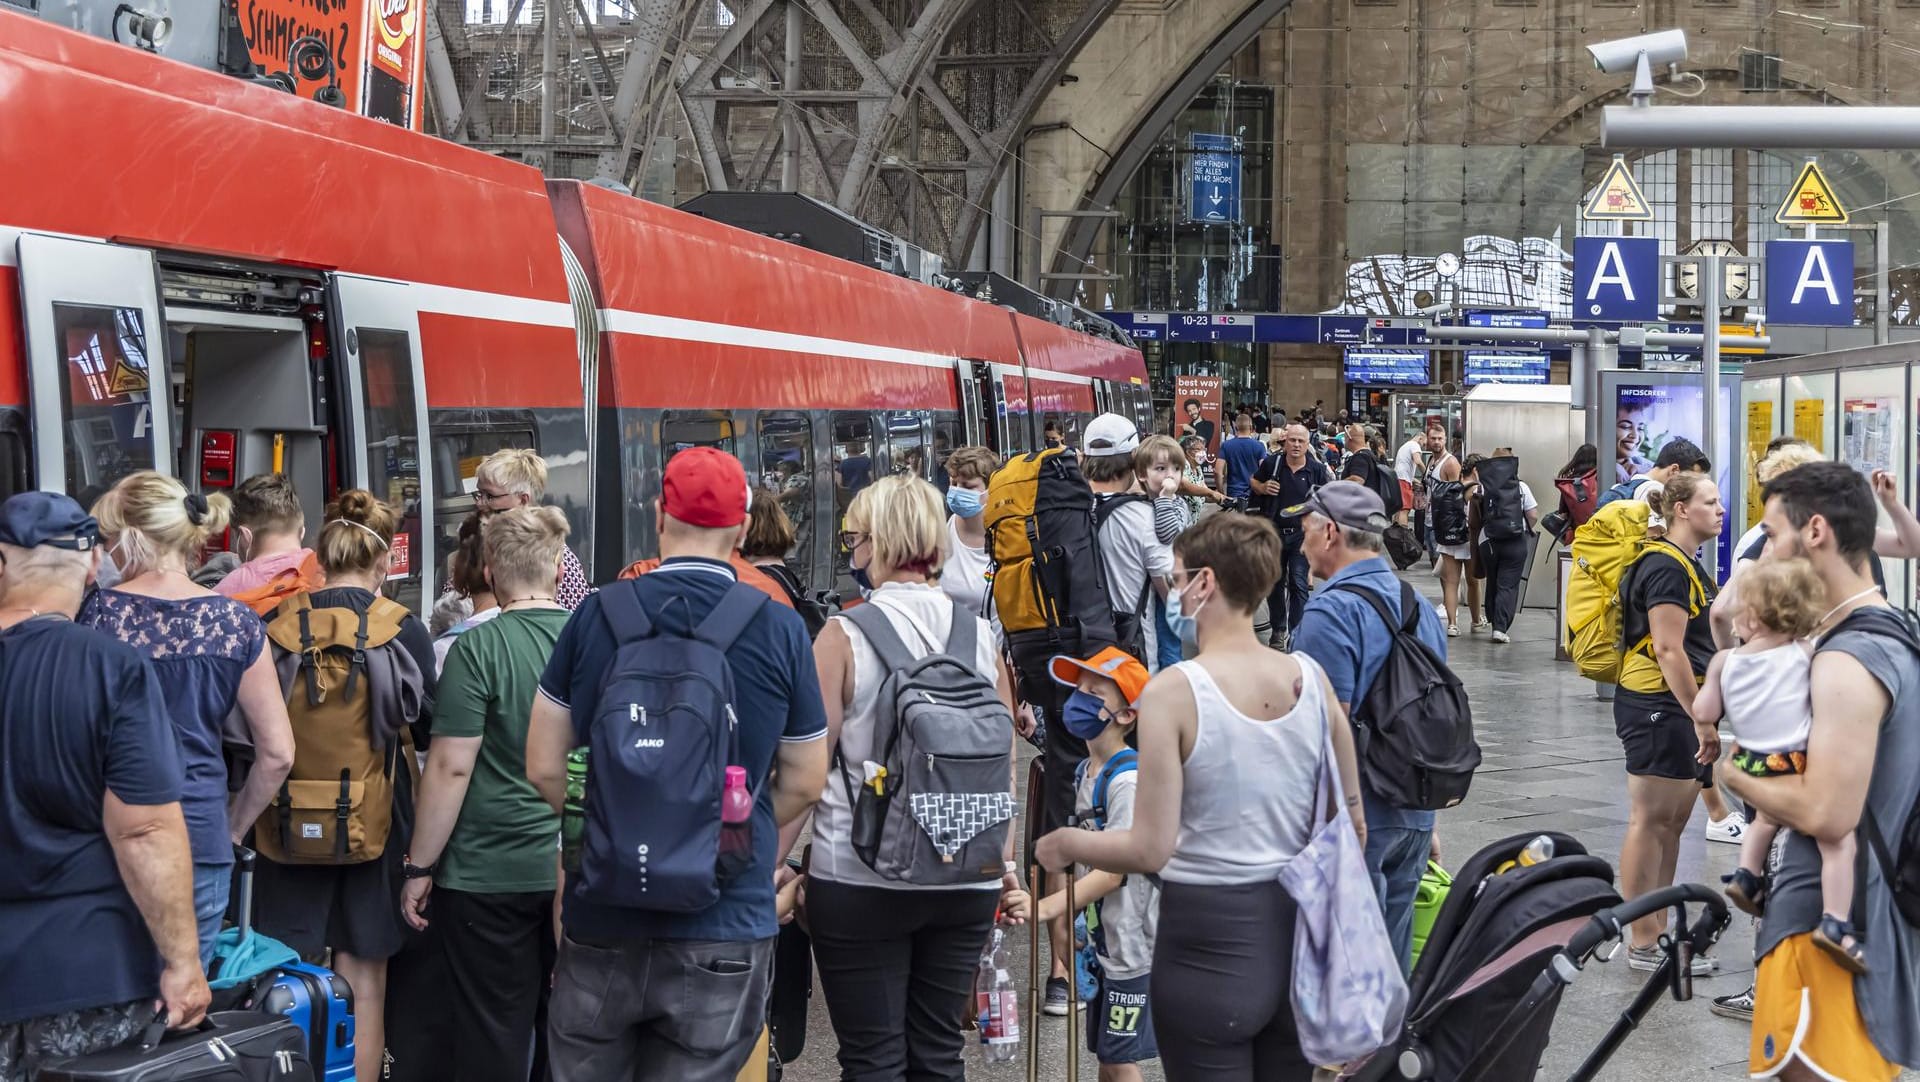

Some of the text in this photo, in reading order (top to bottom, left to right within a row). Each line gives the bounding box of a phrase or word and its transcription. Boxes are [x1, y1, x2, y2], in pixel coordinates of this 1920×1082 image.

[1209, 160, 1229, 169] FINDEN
[1205, 168, 1222, 176] ALLES
[1212, 176, 1232, 184] SHOPS
[1586, 242, 1636, 301] A
[1790, 246, 1840, 305] A
[1182, 315, 1208, 325] 10-23
[1178, 377, 1219, 389] best way
[1178, 388, 1209, 397] to stay
[635, 739, 665, 748] JAKO
[1109, 991, 1147, 1005] STRONG
[1109, 1005, 1140, 1031] 97
